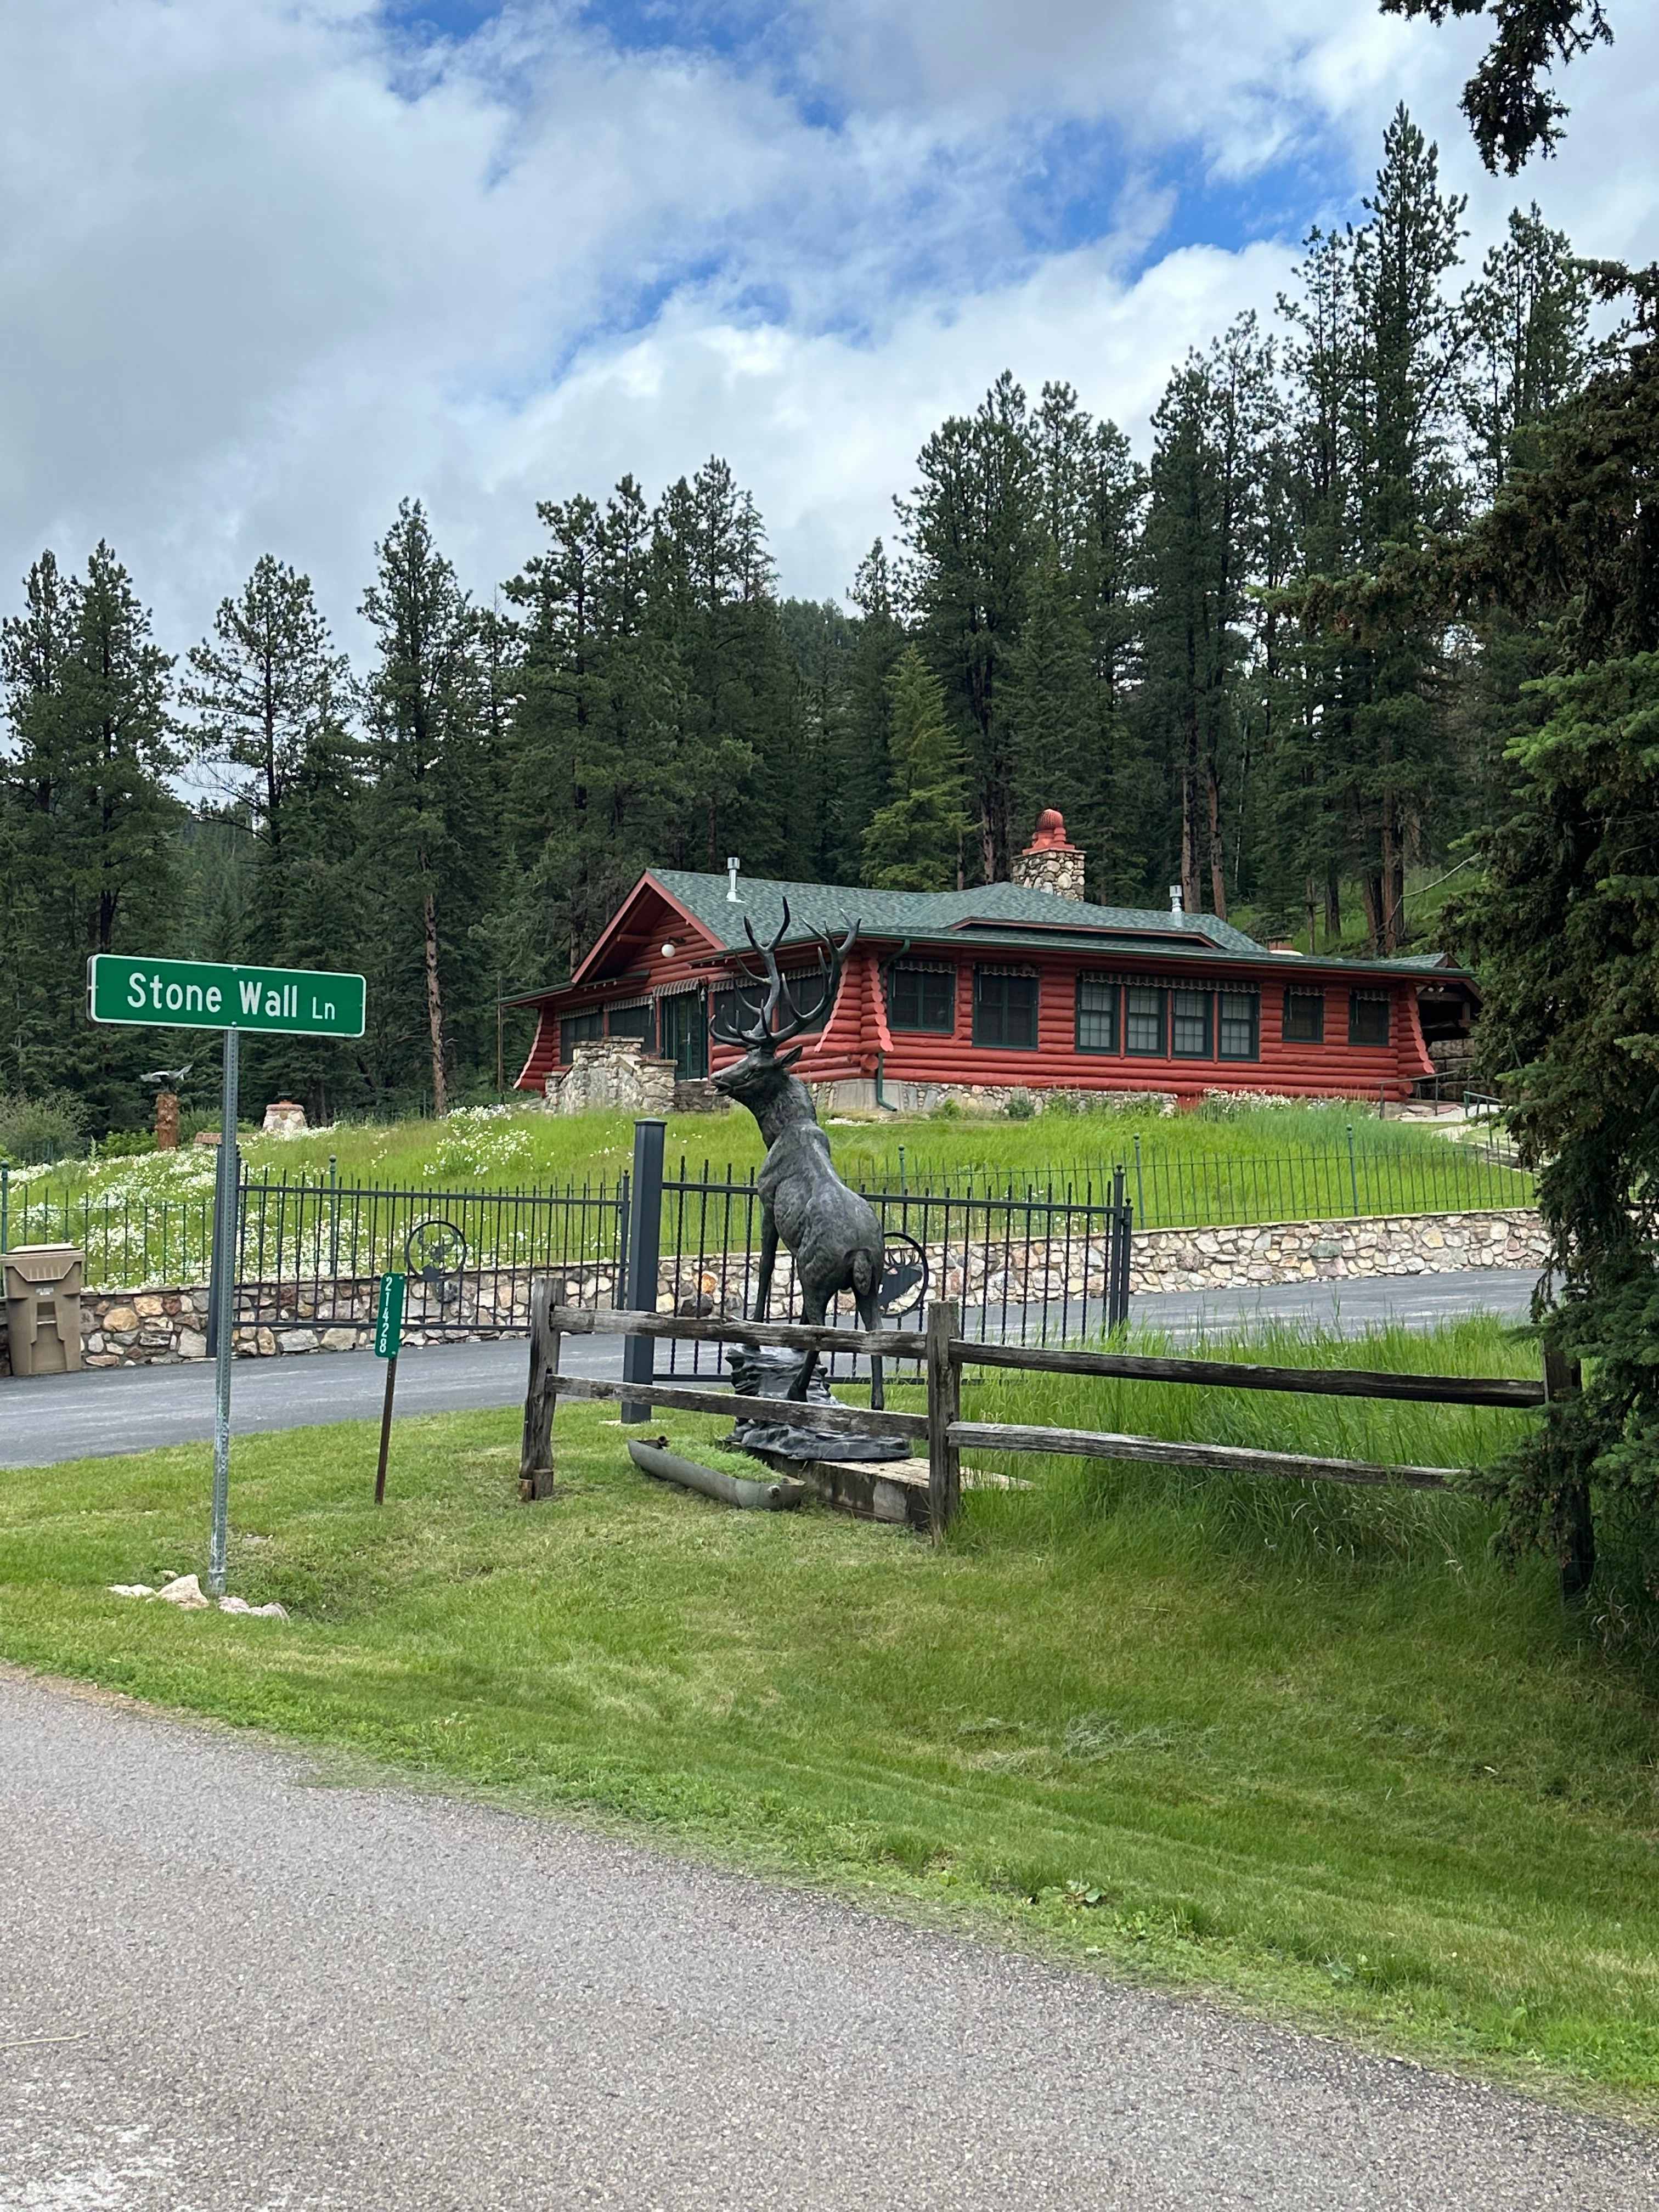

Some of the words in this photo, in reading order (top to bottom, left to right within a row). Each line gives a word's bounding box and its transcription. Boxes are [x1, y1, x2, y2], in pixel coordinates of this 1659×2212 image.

[127, 972, 222, 1013] Stone
[239, 980, 298, 1018] Wall
[312, 996, 336, 1020] Ln
[379, 1276, 393, 1353] 21428
